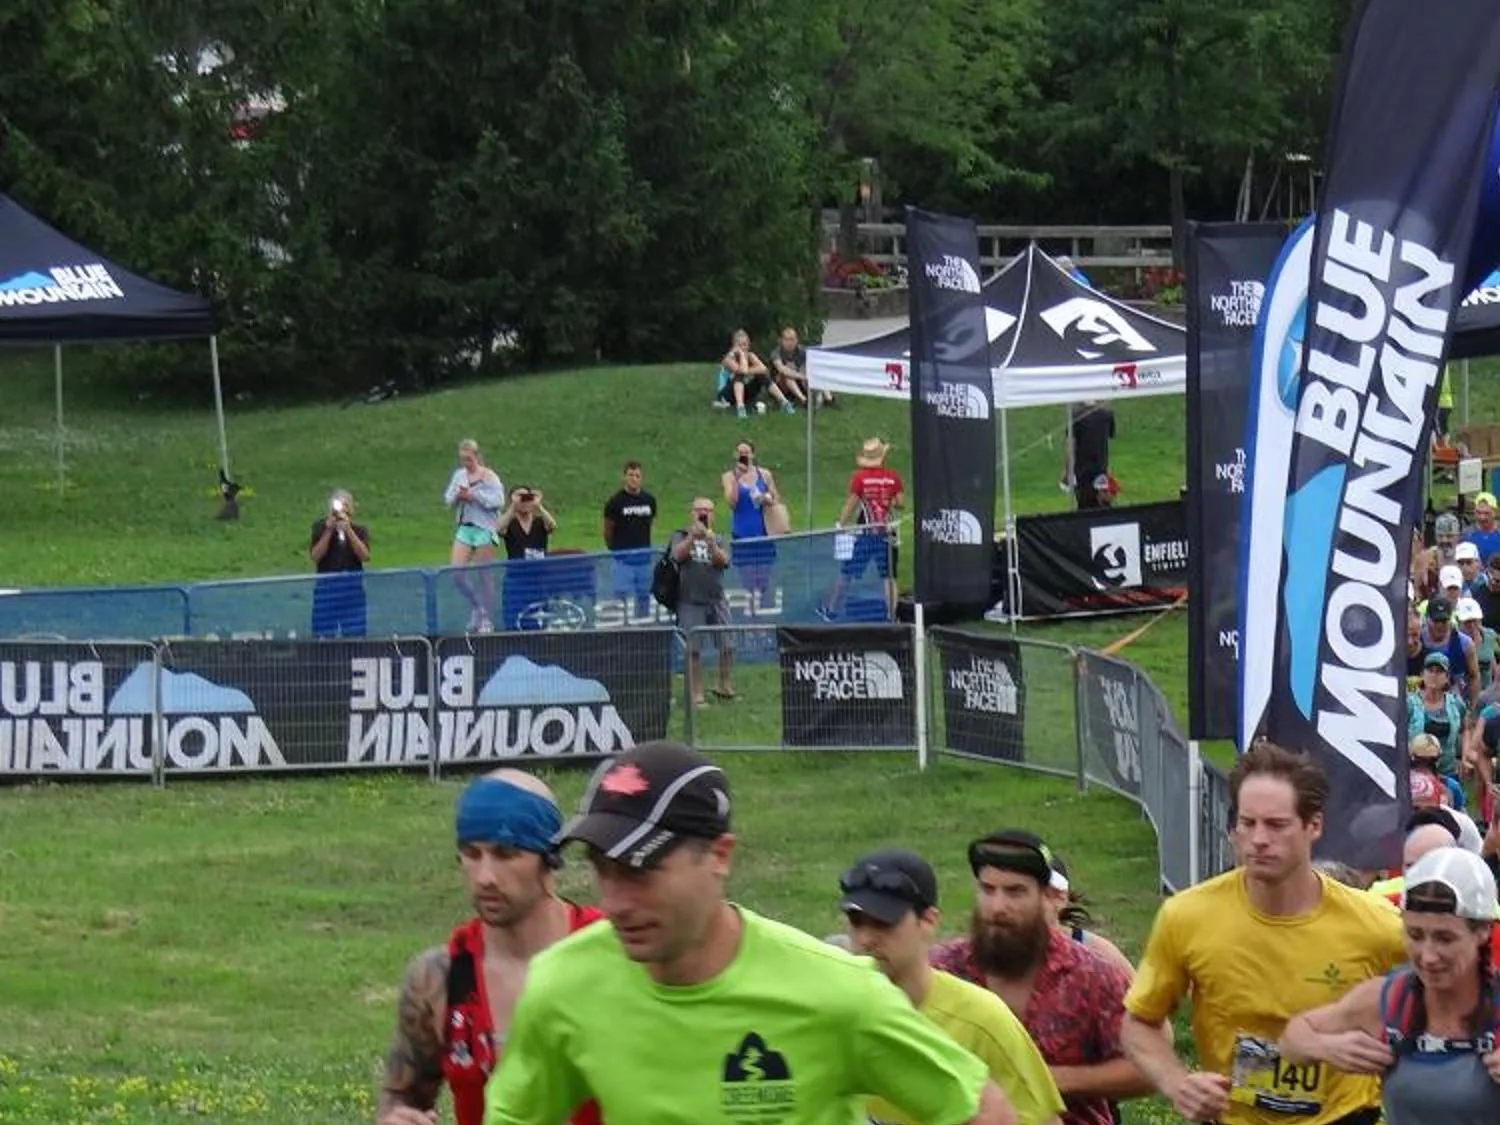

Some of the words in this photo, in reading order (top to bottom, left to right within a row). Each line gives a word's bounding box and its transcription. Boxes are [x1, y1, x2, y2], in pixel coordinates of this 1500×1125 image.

[943, 254, 964, 270] THE
[49, 263, 111, 287] BLUE
[925, 263, 964, 281] NORTH
[1231, 281, 1253, 297] THE
[1211, 294, 1253, 312] NORTH
[1224, 310, 1252, 326] FACE
[1295, 208, 1396, 457] BLUE
[941, 382, 968, 397] THE
[927, 392, 968, 409] NORTH
[935, 403, 968, 419] FACE
[1316, 239, 1456, 800] MOUNTAIN
[795, 661, 866, 682] NORTH
[951, 669, 995, 689] NORTH
[815, 680, 867, 700] FACE
[966, 688, 998, 712] FACE
[1270, 1055, 1321, 1092] 140
